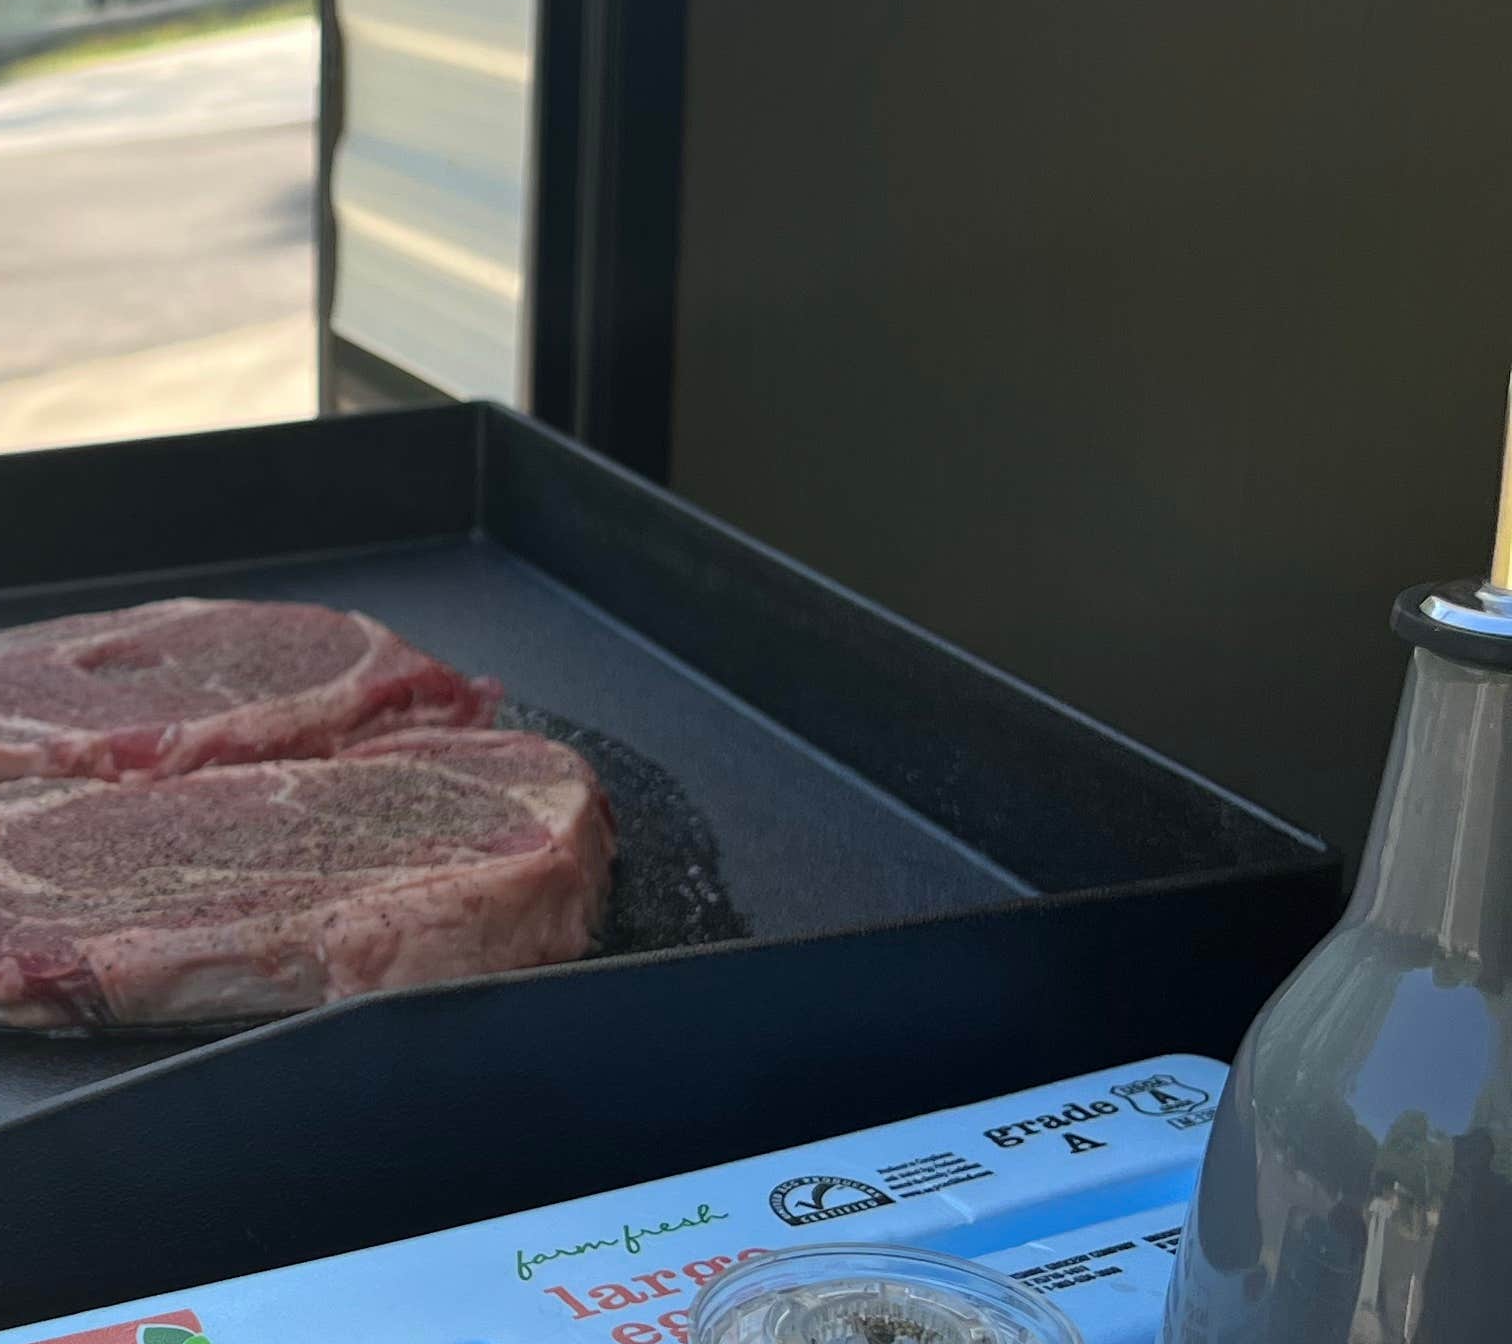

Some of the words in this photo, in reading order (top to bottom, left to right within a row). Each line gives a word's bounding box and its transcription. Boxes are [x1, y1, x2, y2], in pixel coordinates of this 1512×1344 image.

[983, 1101, 1119, 1148] grade
[1062, 1132, 1107, 1154] A
[517, 1250, 619, 1281] farm
[623, 1204, 729, 1254] fresh
[543, 1247, 771, 1320] larg
